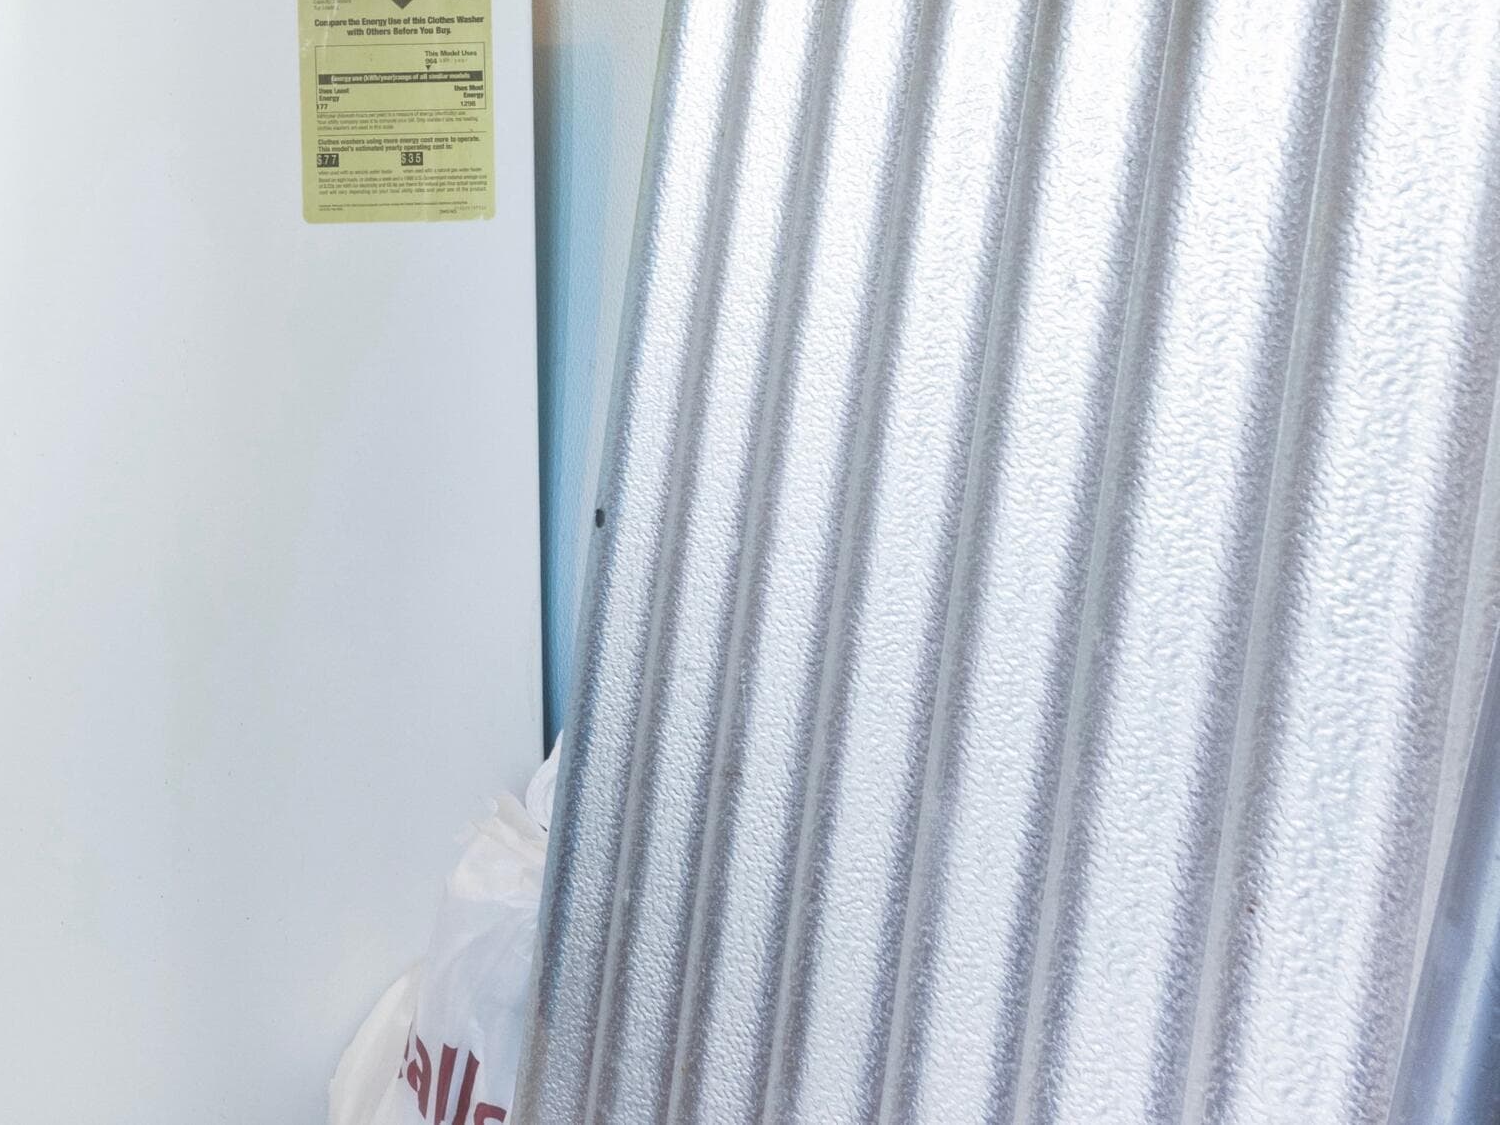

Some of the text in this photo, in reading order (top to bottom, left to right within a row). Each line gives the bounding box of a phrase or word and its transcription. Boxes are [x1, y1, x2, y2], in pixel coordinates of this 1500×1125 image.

[362, 17, 387, 26] Energy
[388, 17, 401, 25] Use
[403, 16, 411, 24] of
[412, 16, 426, 24] this
[428, 16, 455, 24] Clothes
[456, 15, 484, 23] Washer
[393, 27, 418, 35] Before
[419, 26, 434, 35] You
[319, 95, 340, 103] Energy
